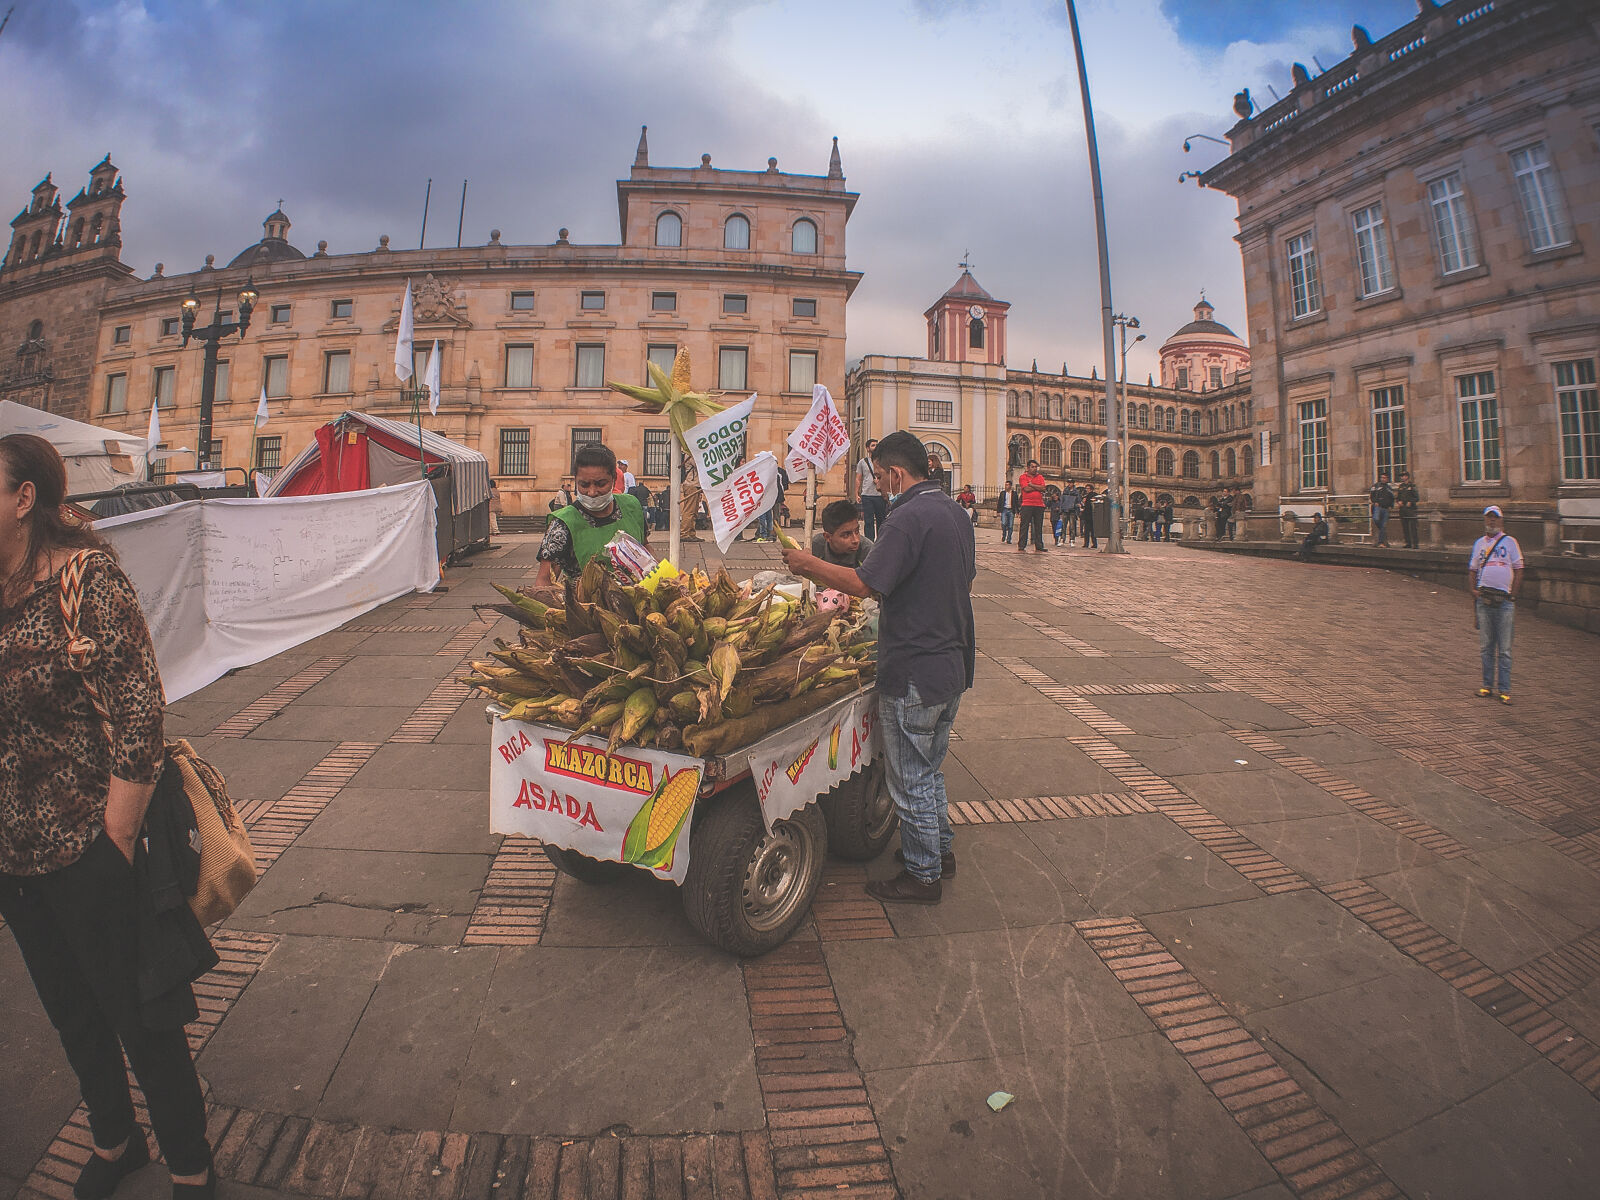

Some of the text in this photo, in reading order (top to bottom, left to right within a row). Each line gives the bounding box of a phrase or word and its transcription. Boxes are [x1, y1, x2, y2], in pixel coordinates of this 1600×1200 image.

[747, 470, 764, 494] NO
[497, 730, 653, 793] RICA MAZORCA
[512, 778, 605, 833] ASADA
